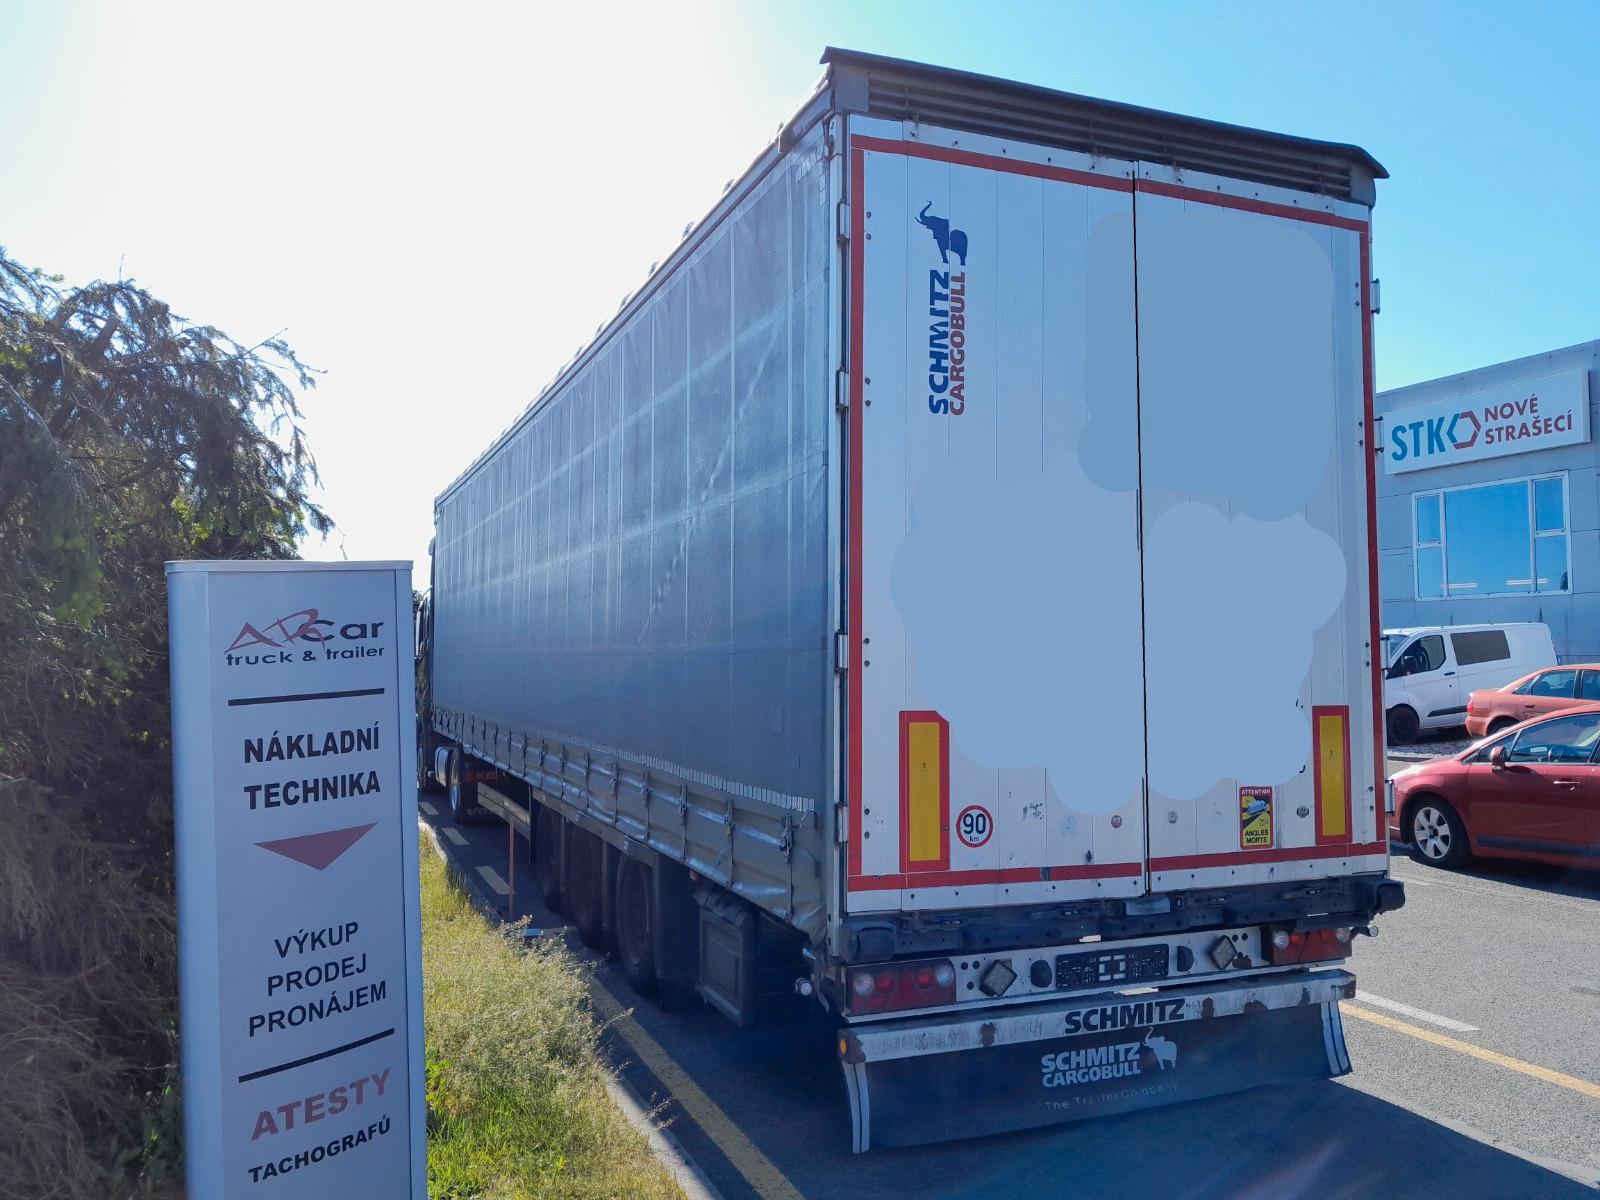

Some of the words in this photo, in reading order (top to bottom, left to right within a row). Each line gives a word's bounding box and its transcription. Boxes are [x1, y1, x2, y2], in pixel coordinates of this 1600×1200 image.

[928, 269, 949, 415] SCHMITZ
[949, 271, 966, 416] CARGOBULL
[1484, 393, 1539, 423] NOVÉ
[1391, 416, 1446, 461] STK
[1484, 409, 1573, 445] STRAŠECÍ
[226, 651, 293, 666] truck
[302, 650, 316, 662] &
[325, 646, 385, 660] trailer
[244, 721, 380, 763] NÁKLADNÍ
[243, 770, 381, 810] TECHNIKA
[1241, 788, 1271, 796] ATTENTION
[962, 813, 987, 835] 90
[969, 835, 980, 843] km
[1245, 829, 1269, 837] ANGLES
[1246, 836, 1268, 844] MORTS
[274, 921, 359, 959] VÝKUP
[267, 953, 367, 997] PRODEJ
[249, 980, 387, 1038] PRONÁJEM
[1064, 998, 1186, 1034] SCHMITZ
[1041, 1042, 1141, 1073] SCHMITZ
[1041, 1061, 1141, 1088] CARGOBULL
[251, 1067, 391, 1141] ATESTY
[248, 1114, 390, 1184] TACHOGRAFŮ
